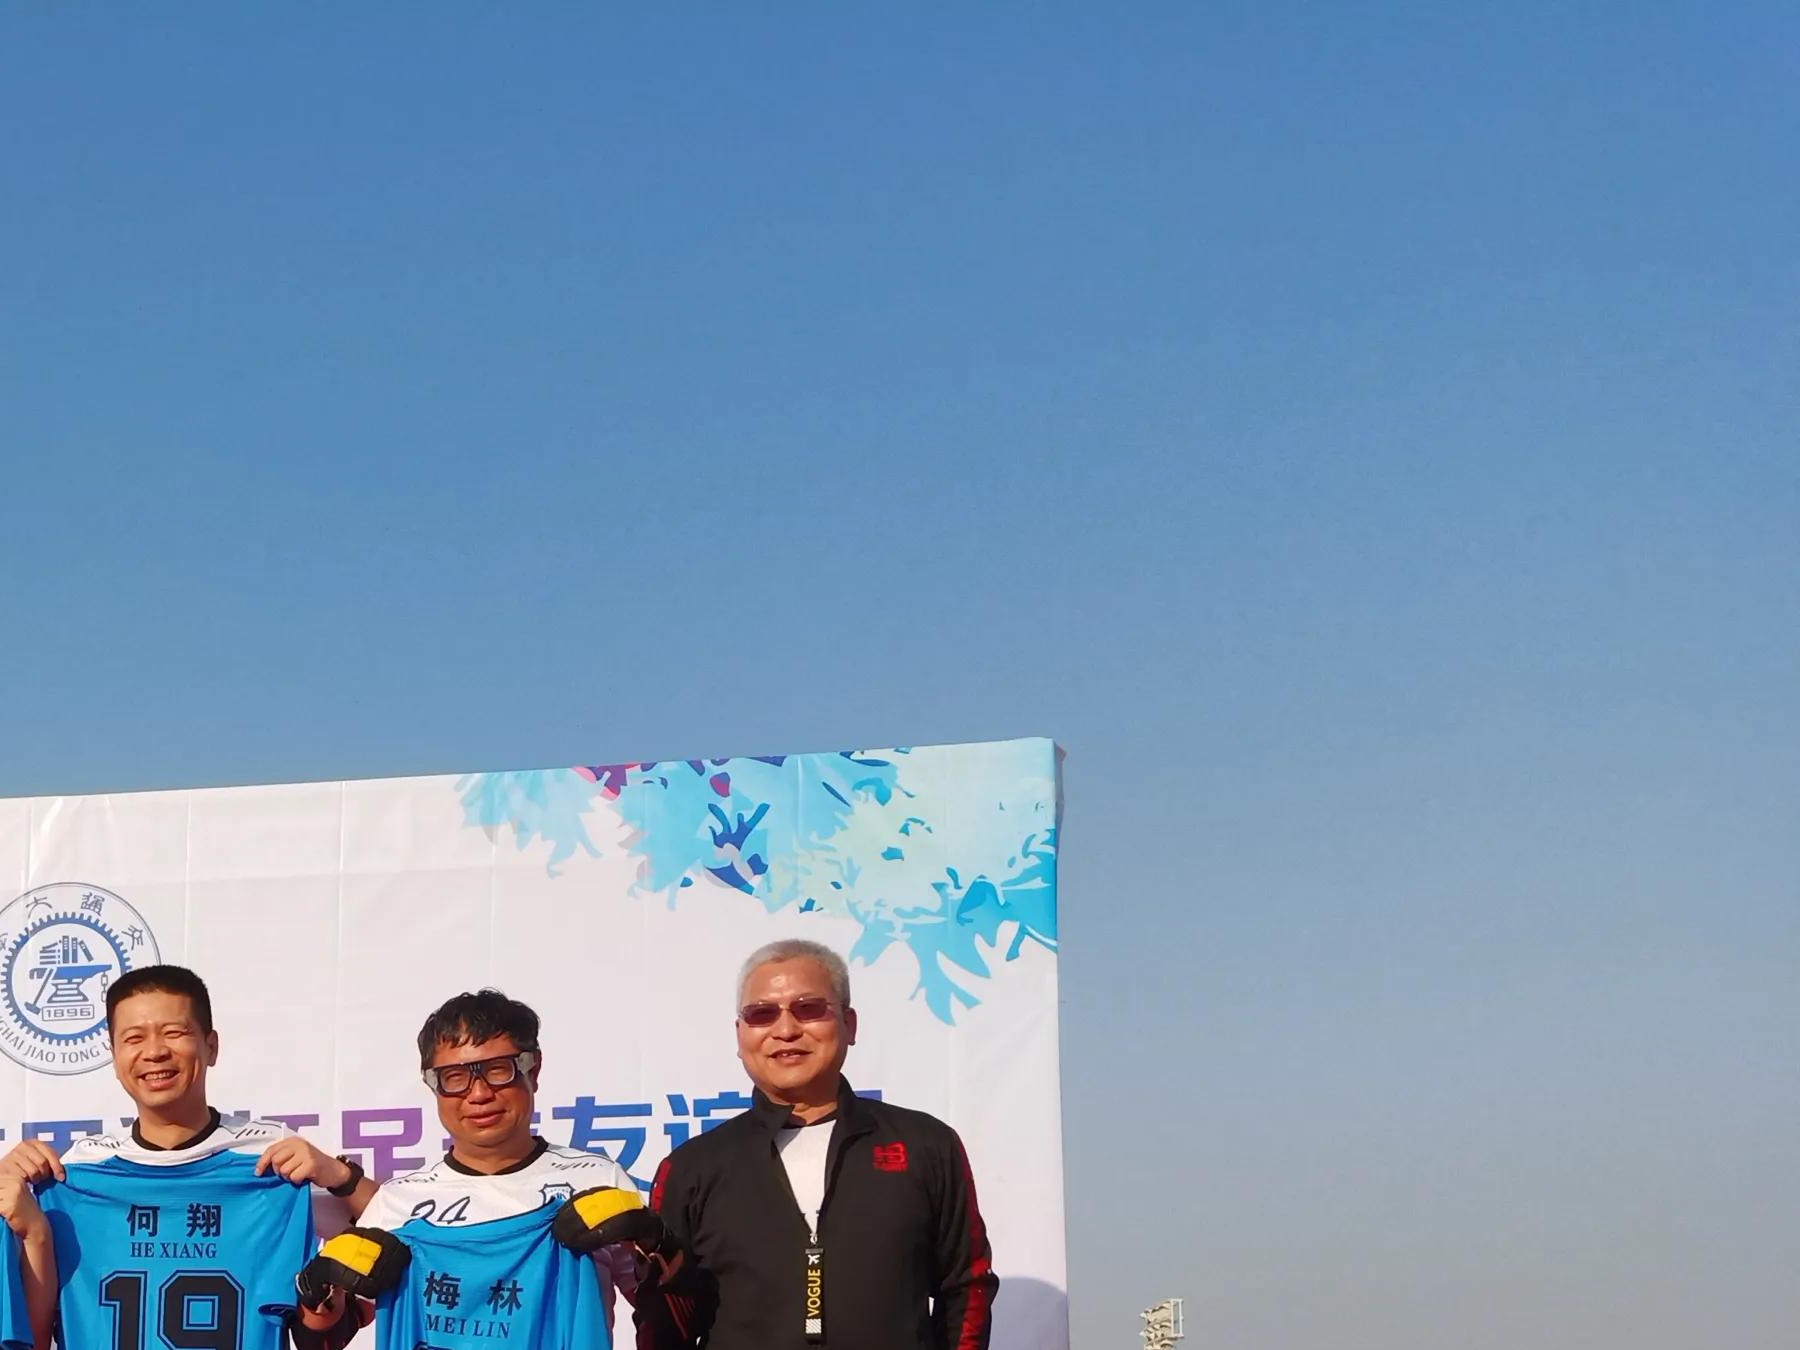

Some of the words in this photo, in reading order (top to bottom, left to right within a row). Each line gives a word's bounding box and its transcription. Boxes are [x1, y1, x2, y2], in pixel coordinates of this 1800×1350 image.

[45, 1007, 92, 1019] 1896
[24, 1042, 56, 1063] JIAO
[61, 1045, 101, 1064] TONG
[126, 1202, 222, 1238] 何翔
[130, 1241, 155, 1258] HE
[160, 1242, 217, 1259] XIANG
[423, 1270, 523, 1316] 梅林
[807, 1268, 822, 1317] VOGUE
[425, 1314, 468, 1335] MEI
[472, 1319, 511, 1339] LIN
